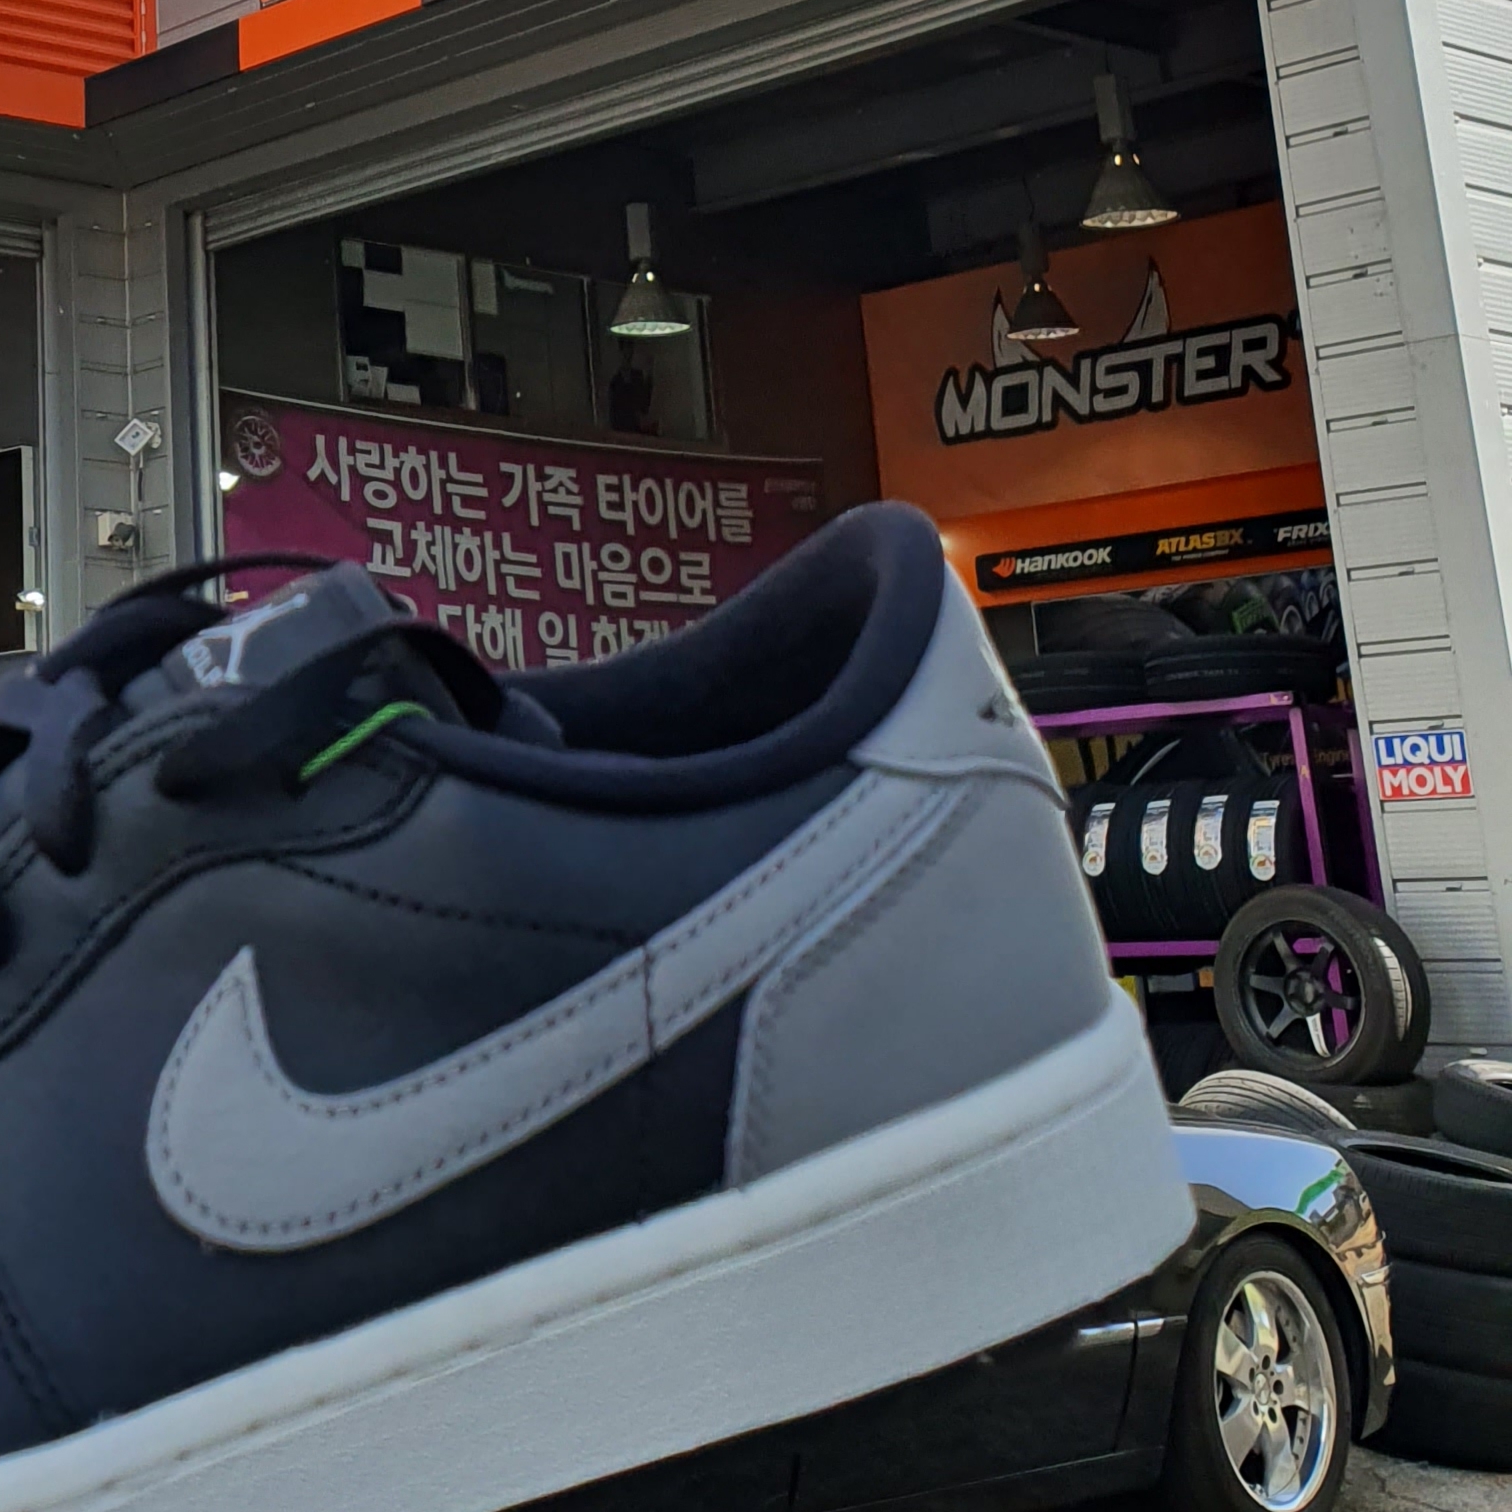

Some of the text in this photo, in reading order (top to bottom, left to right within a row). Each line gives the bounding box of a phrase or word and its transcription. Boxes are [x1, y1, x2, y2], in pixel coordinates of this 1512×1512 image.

[938, 320, 1286, 441] MONSTER
[307, 434, 487, 521] 사랑하는
[500, 462, 584, 531] 가족
[597, 474, 753, 544] 타이어를
[366, 517, 718, 608] 교체하는 마음으로
[1375, 731, 1463, 766] LIQUI
[1380, 765, 1471, 797] MOLY
